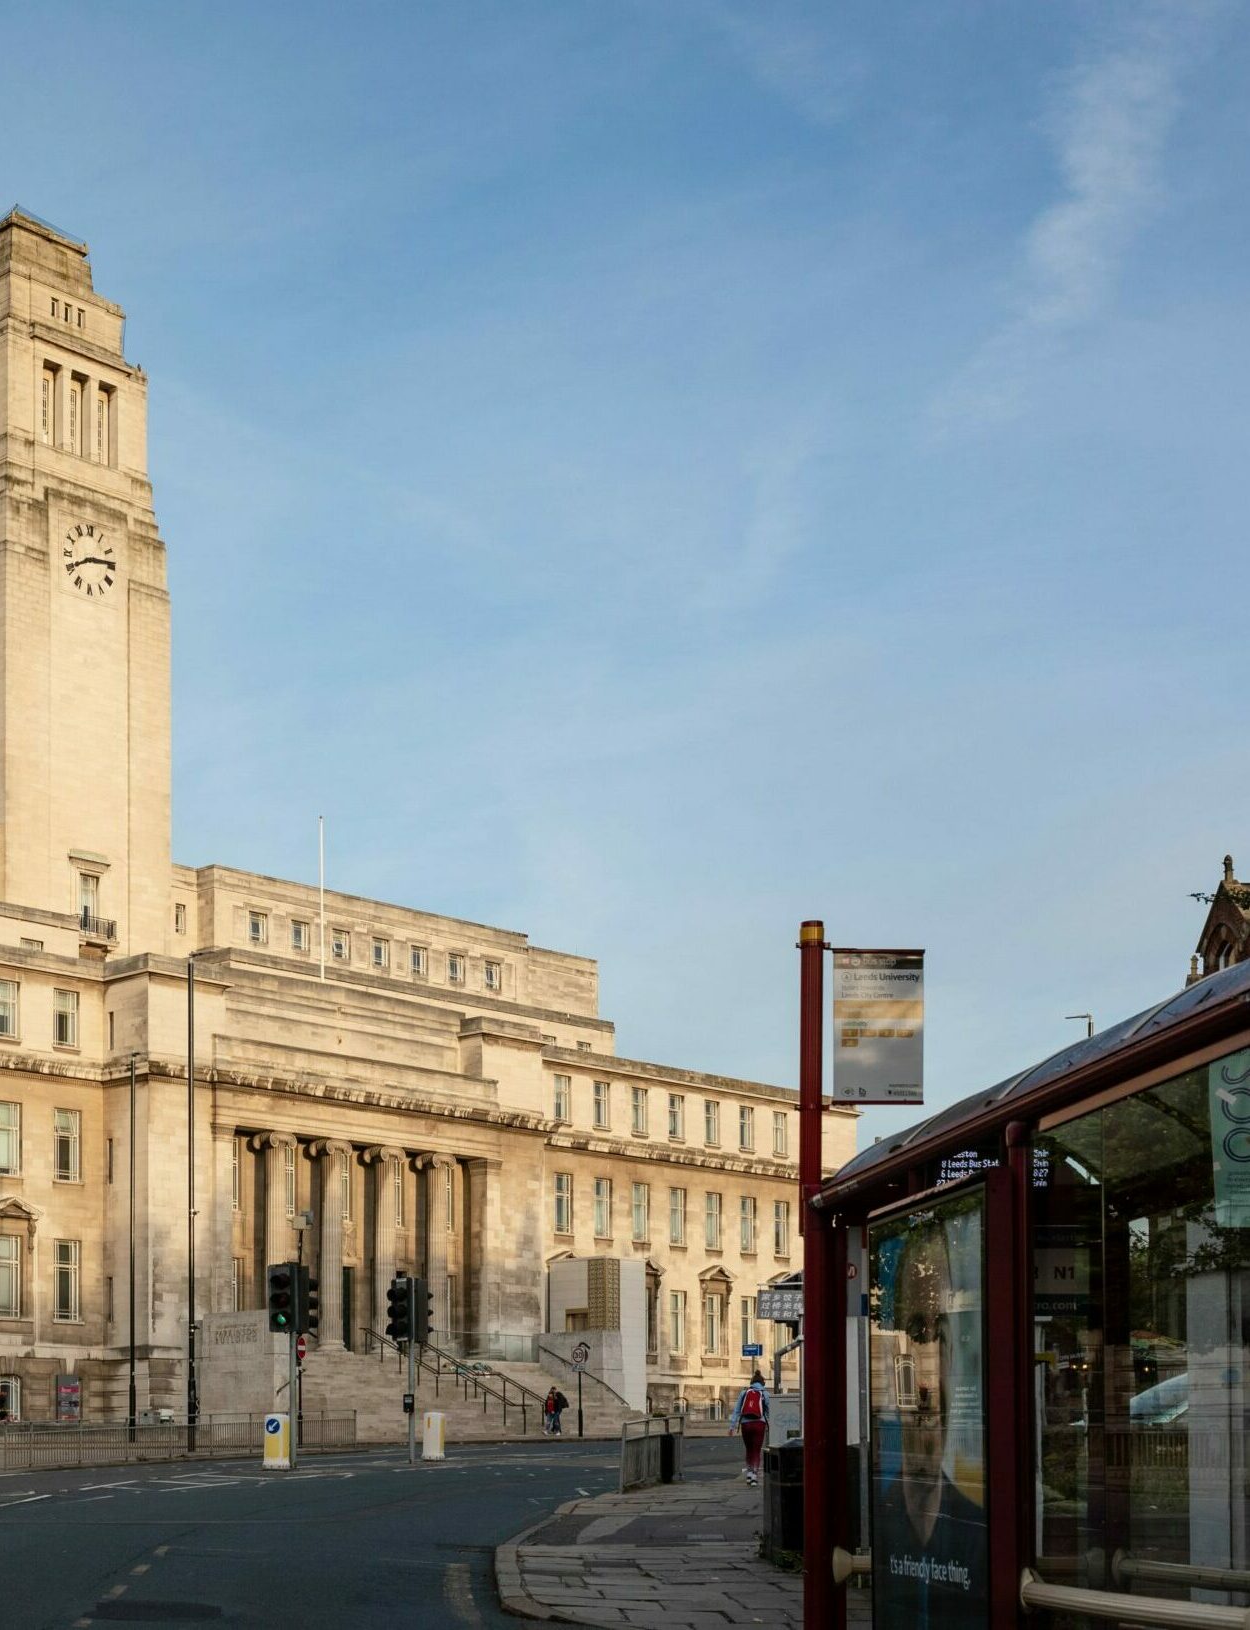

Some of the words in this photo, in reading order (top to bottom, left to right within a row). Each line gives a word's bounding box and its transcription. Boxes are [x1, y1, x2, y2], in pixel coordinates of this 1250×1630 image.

[853, 972, 878, 981] Leeds
[879, 972, 920, 983] University
[948, 1159, 968, 1168] Leeds
[968, 1159, 982, 1168] Bus
[1054, 1266, 1075, 1280] N1
[898, 1560, 903, 1575] a
[903, 1554, 930, 1584] friendly
[931, 1557, 948, 1581] face
